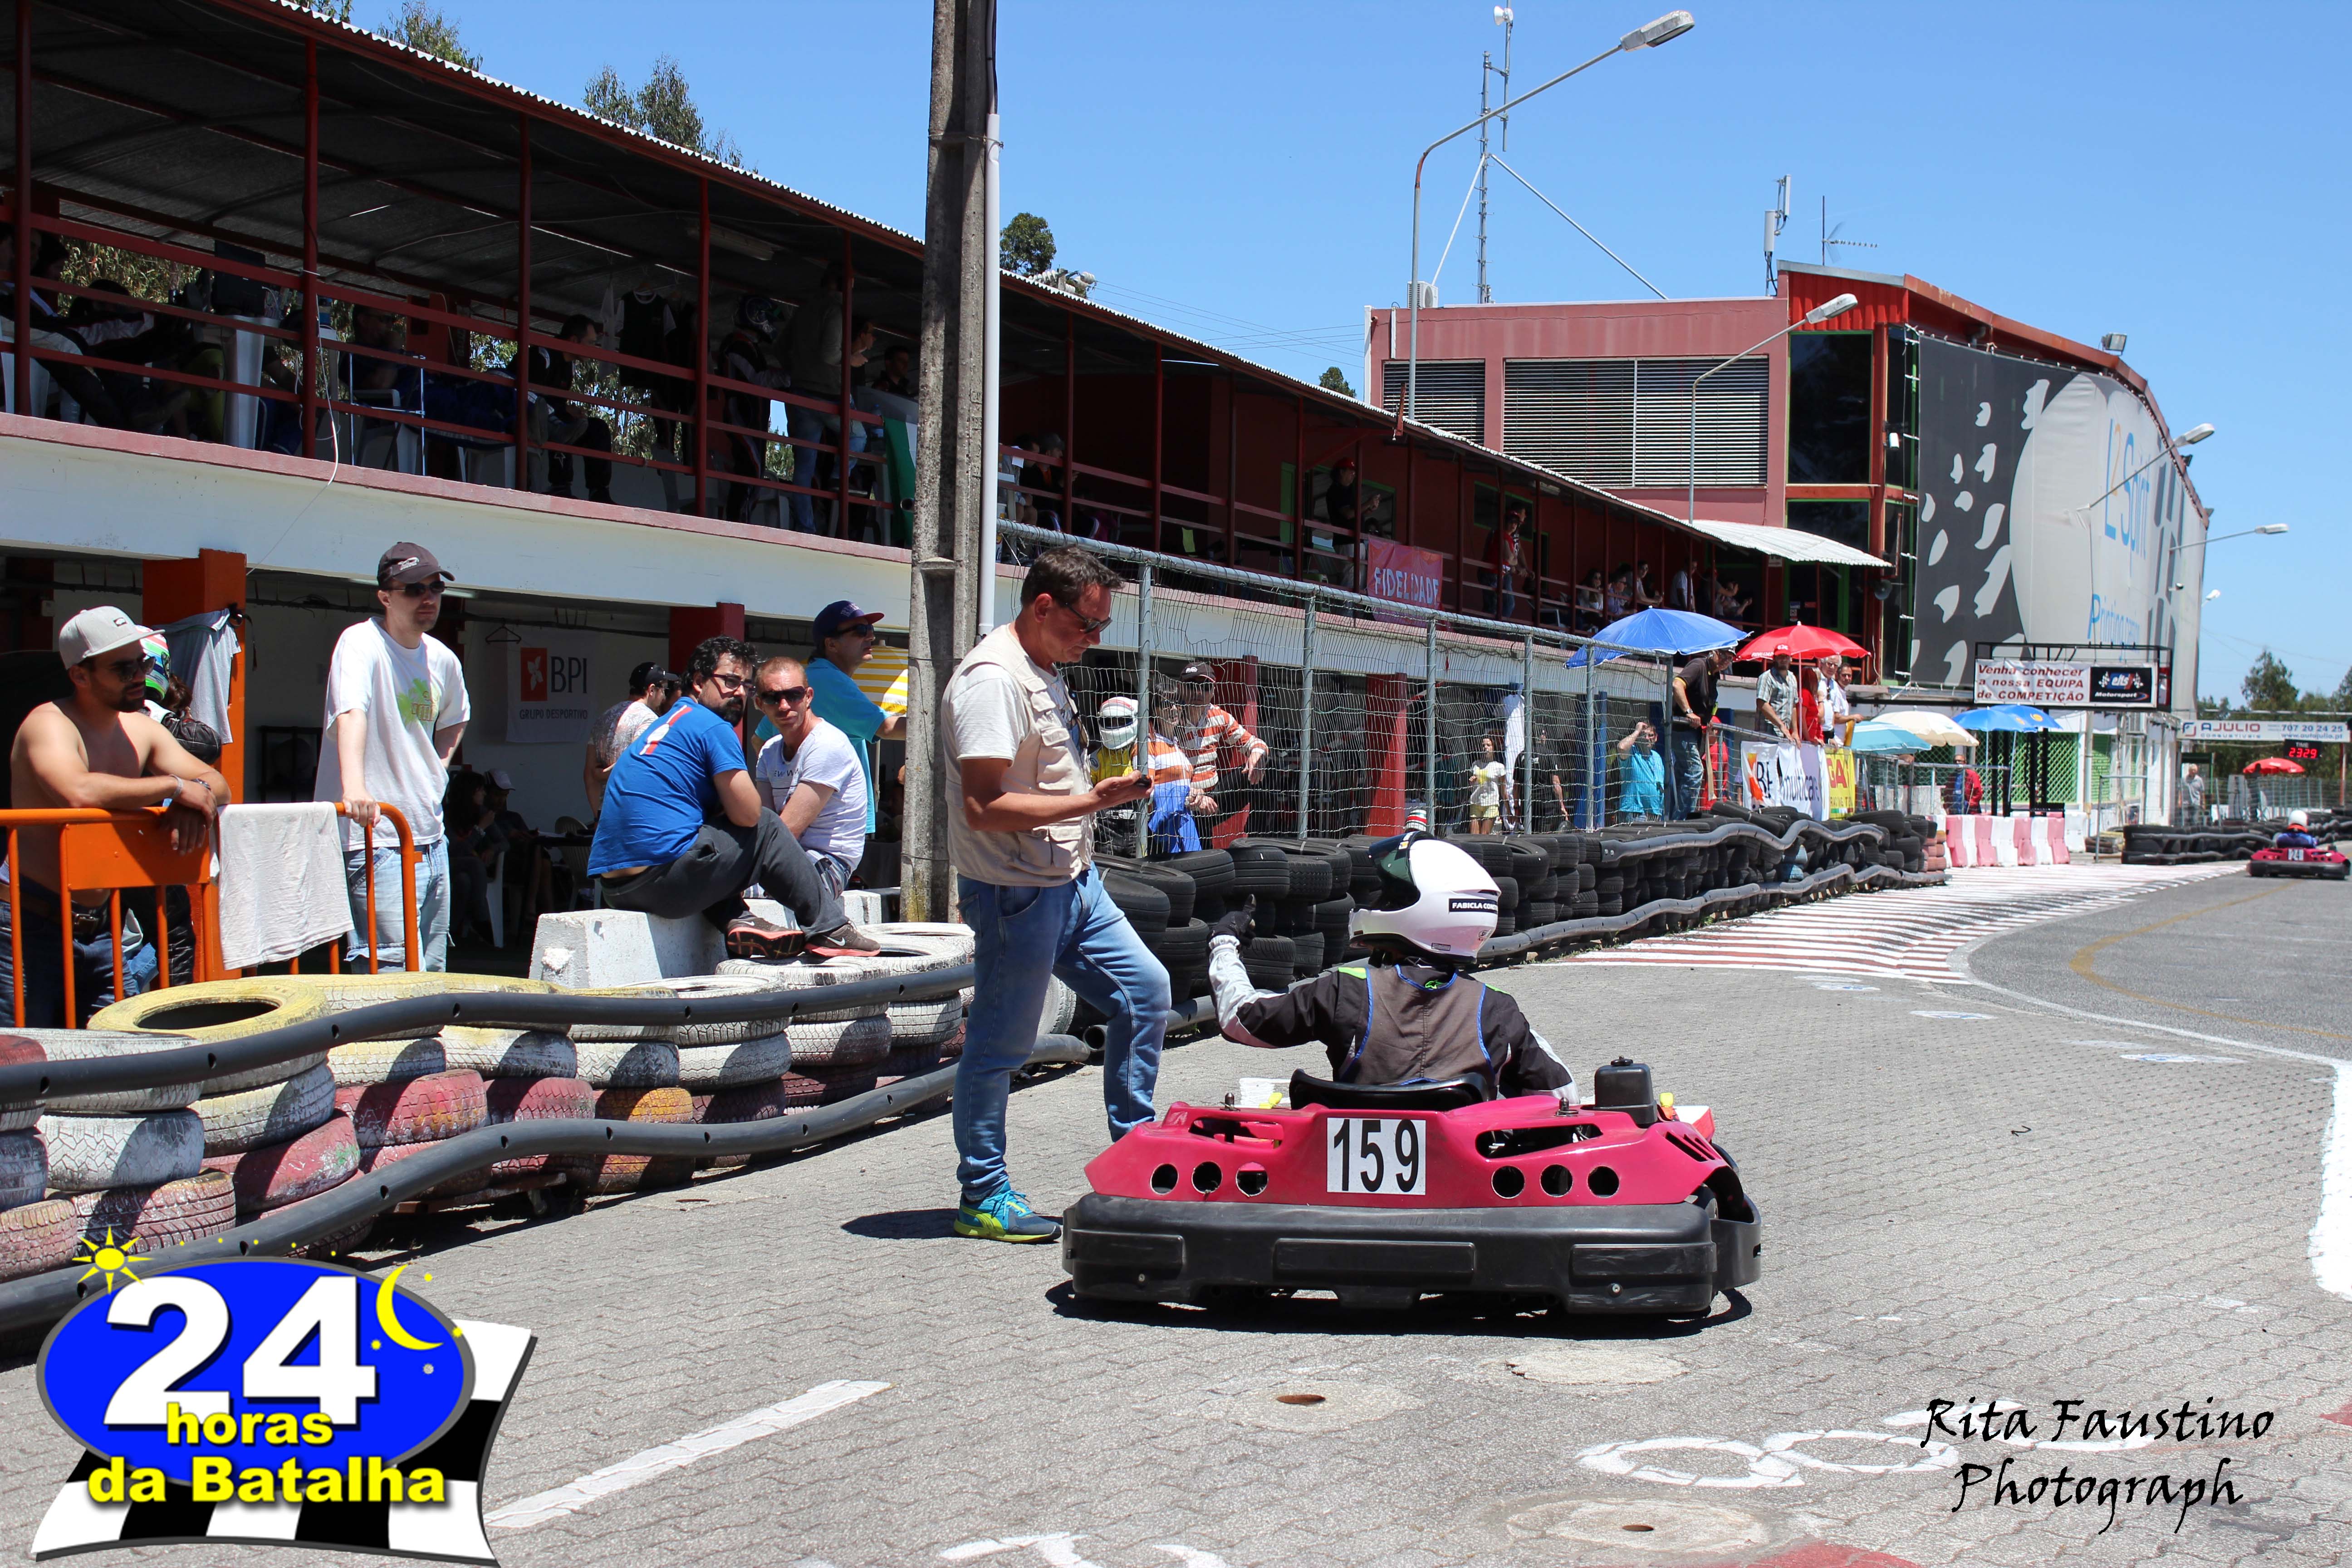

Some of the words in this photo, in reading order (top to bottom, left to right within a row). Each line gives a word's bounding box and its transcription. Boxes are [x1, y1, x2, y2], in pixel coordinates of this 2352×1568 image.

[550, 656, 588, 694] BPI
[1978, 665, 2017, 675] Venha
[2022, 666, 2084, 676] conhecer
[2036, 679, 2084, 688] EQUIPA
[1977, 691, 1992, 699] de
[1998, 691, 2084, 702] COMPETIÇÃO
[519, 709, 544, 719] GRUPO
[546, 709, 588, 720] DESPORTIVO
[1334, 1118, 1419, 1192] 159
